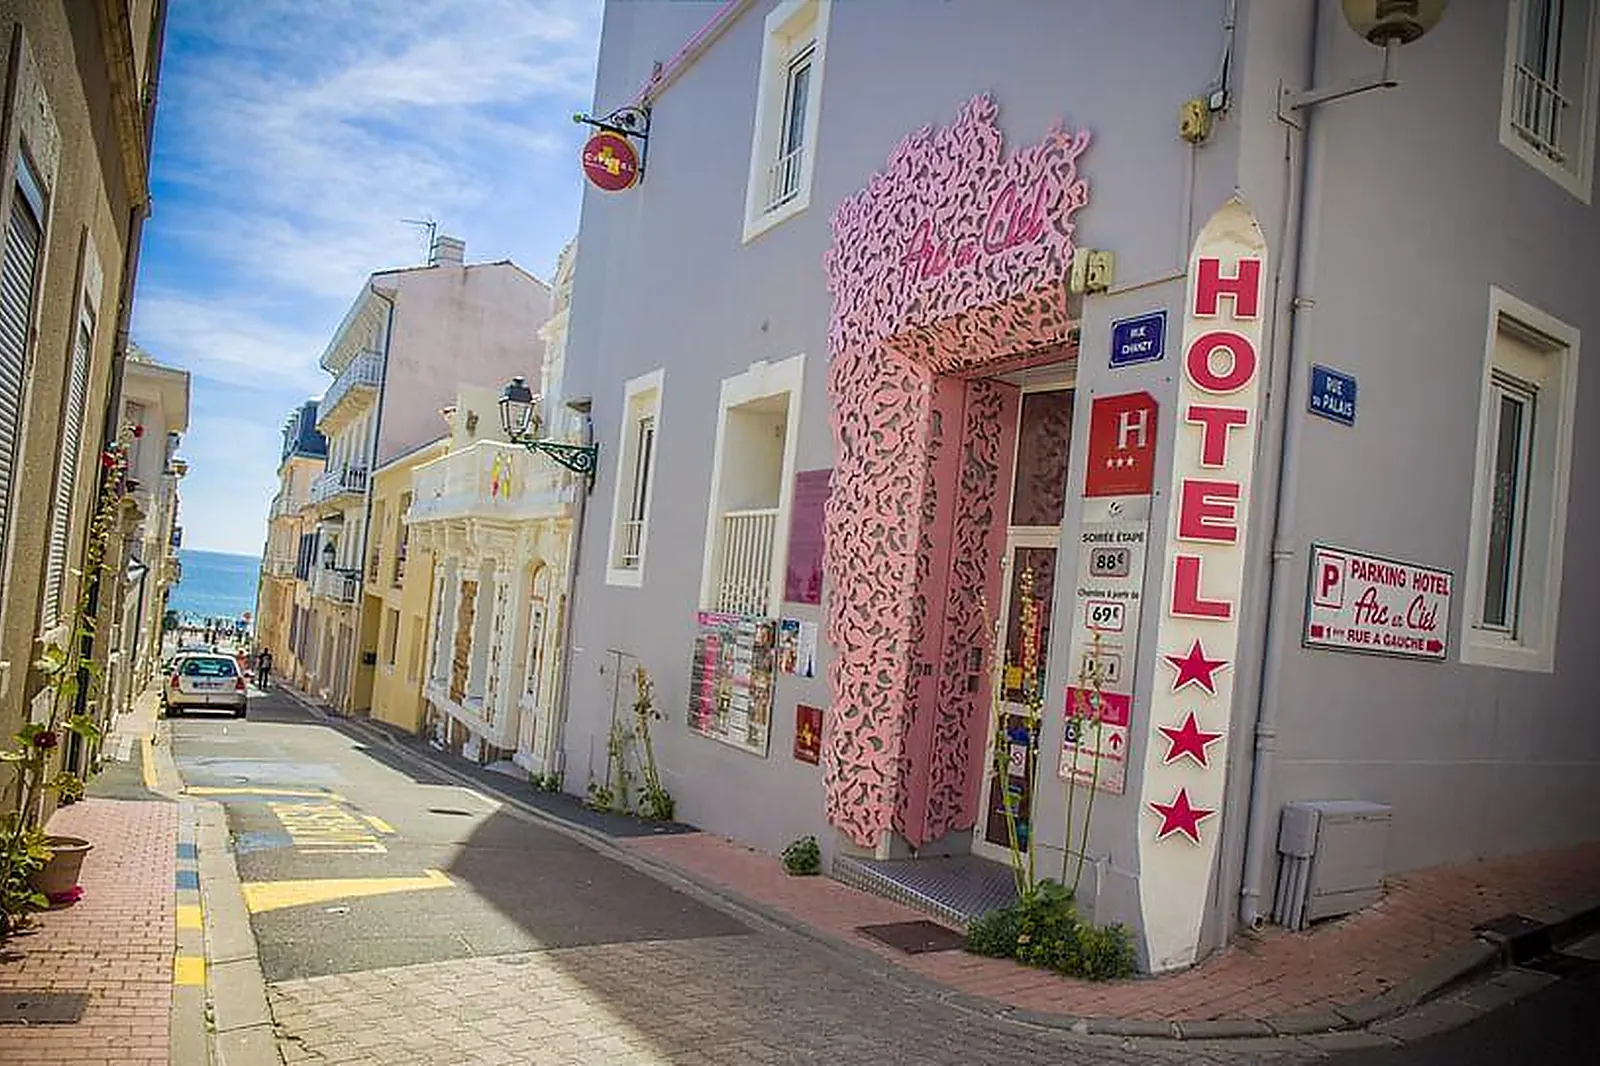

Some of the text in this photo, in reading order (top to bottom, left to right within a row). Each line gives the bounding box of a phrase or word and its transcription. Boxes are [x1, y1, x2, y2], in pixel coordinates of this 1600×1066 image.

[983, 175, 1049, 255] Ciel
[1326, 376, 1343, 396] RUE
[1322, 394, 1353, 418] PALAIS
[1117, 408, 1149, 450] H
[1170, 256, 1262, 620] HOTEL
[1322, 563, 1339, 598] P
[1351, 559, 1450, 597] PARKING HOTEL
[1354, 586, 1389, 626] Arc
[1406, 594, 1439, 632] Ciel
[1347, 629, 1371, 645] RUE
[1372, 633, 1382, 646] A
[1383, 634, 1424, 651] GAUCHE
